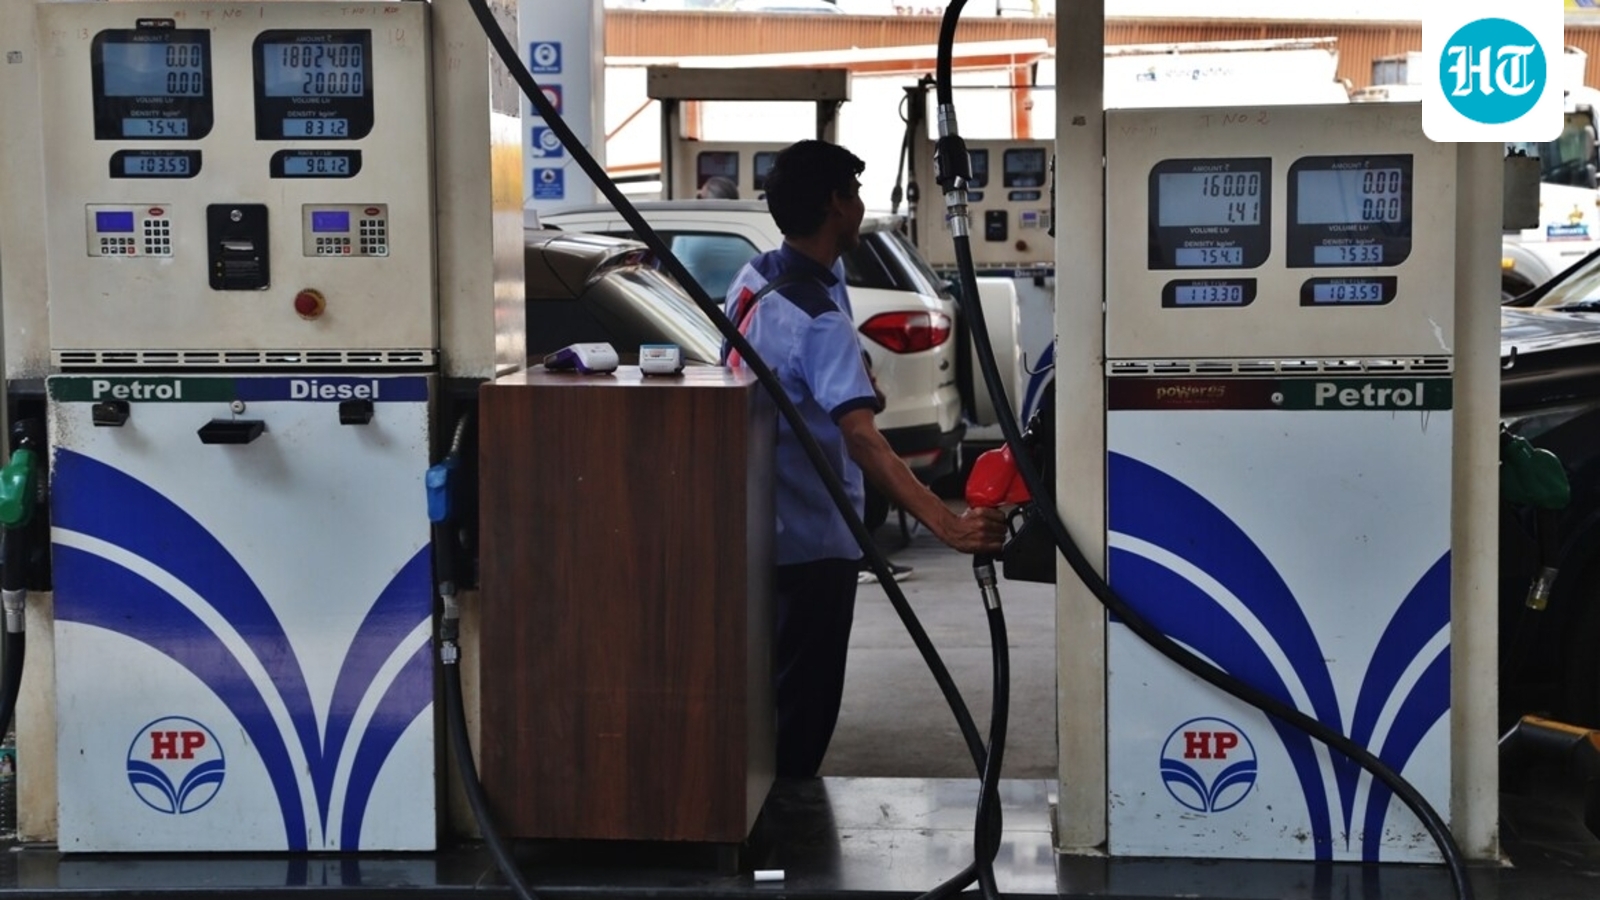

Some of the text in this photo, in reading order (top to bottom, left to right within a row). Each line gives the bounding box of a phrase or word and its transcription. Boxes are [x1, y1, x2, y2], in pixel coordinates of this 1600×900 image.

[166, 45, 200, 67] 0.00
[282, 46, 361, 68] 18024.00
[167, 72, 201, 94] 0.00
[303, 72, 361, 94] 200.00
[147, 121, 186, 134] 754.1
[305, 121, 345, 135] 831.2
[140, 158, 188, 172] 103.59
[307, 159, 347, 173] 90.12
[1203, 174, 1259, 197] 160.00
[1363, 171, 1400, 194] 0.00
[1228, 202, 1258, 223] 1.41
[1362, 198, 1399, 221] 0.00
[1200, 249, 1240, 264] 754.1
[1340, 246, 1379, 262] 753.5
[1191, 287, 1240, 302] 113.30
[1330, 285, 1379, 300] 103.59
[92, 380, 182, 399] Petrol
[290, 380, 379, 399] Diesel
[1315, 382, 1425, 407] Petrol
[150, 731, 206, 760] HP
[1183, 731, 1239, 760] HP
